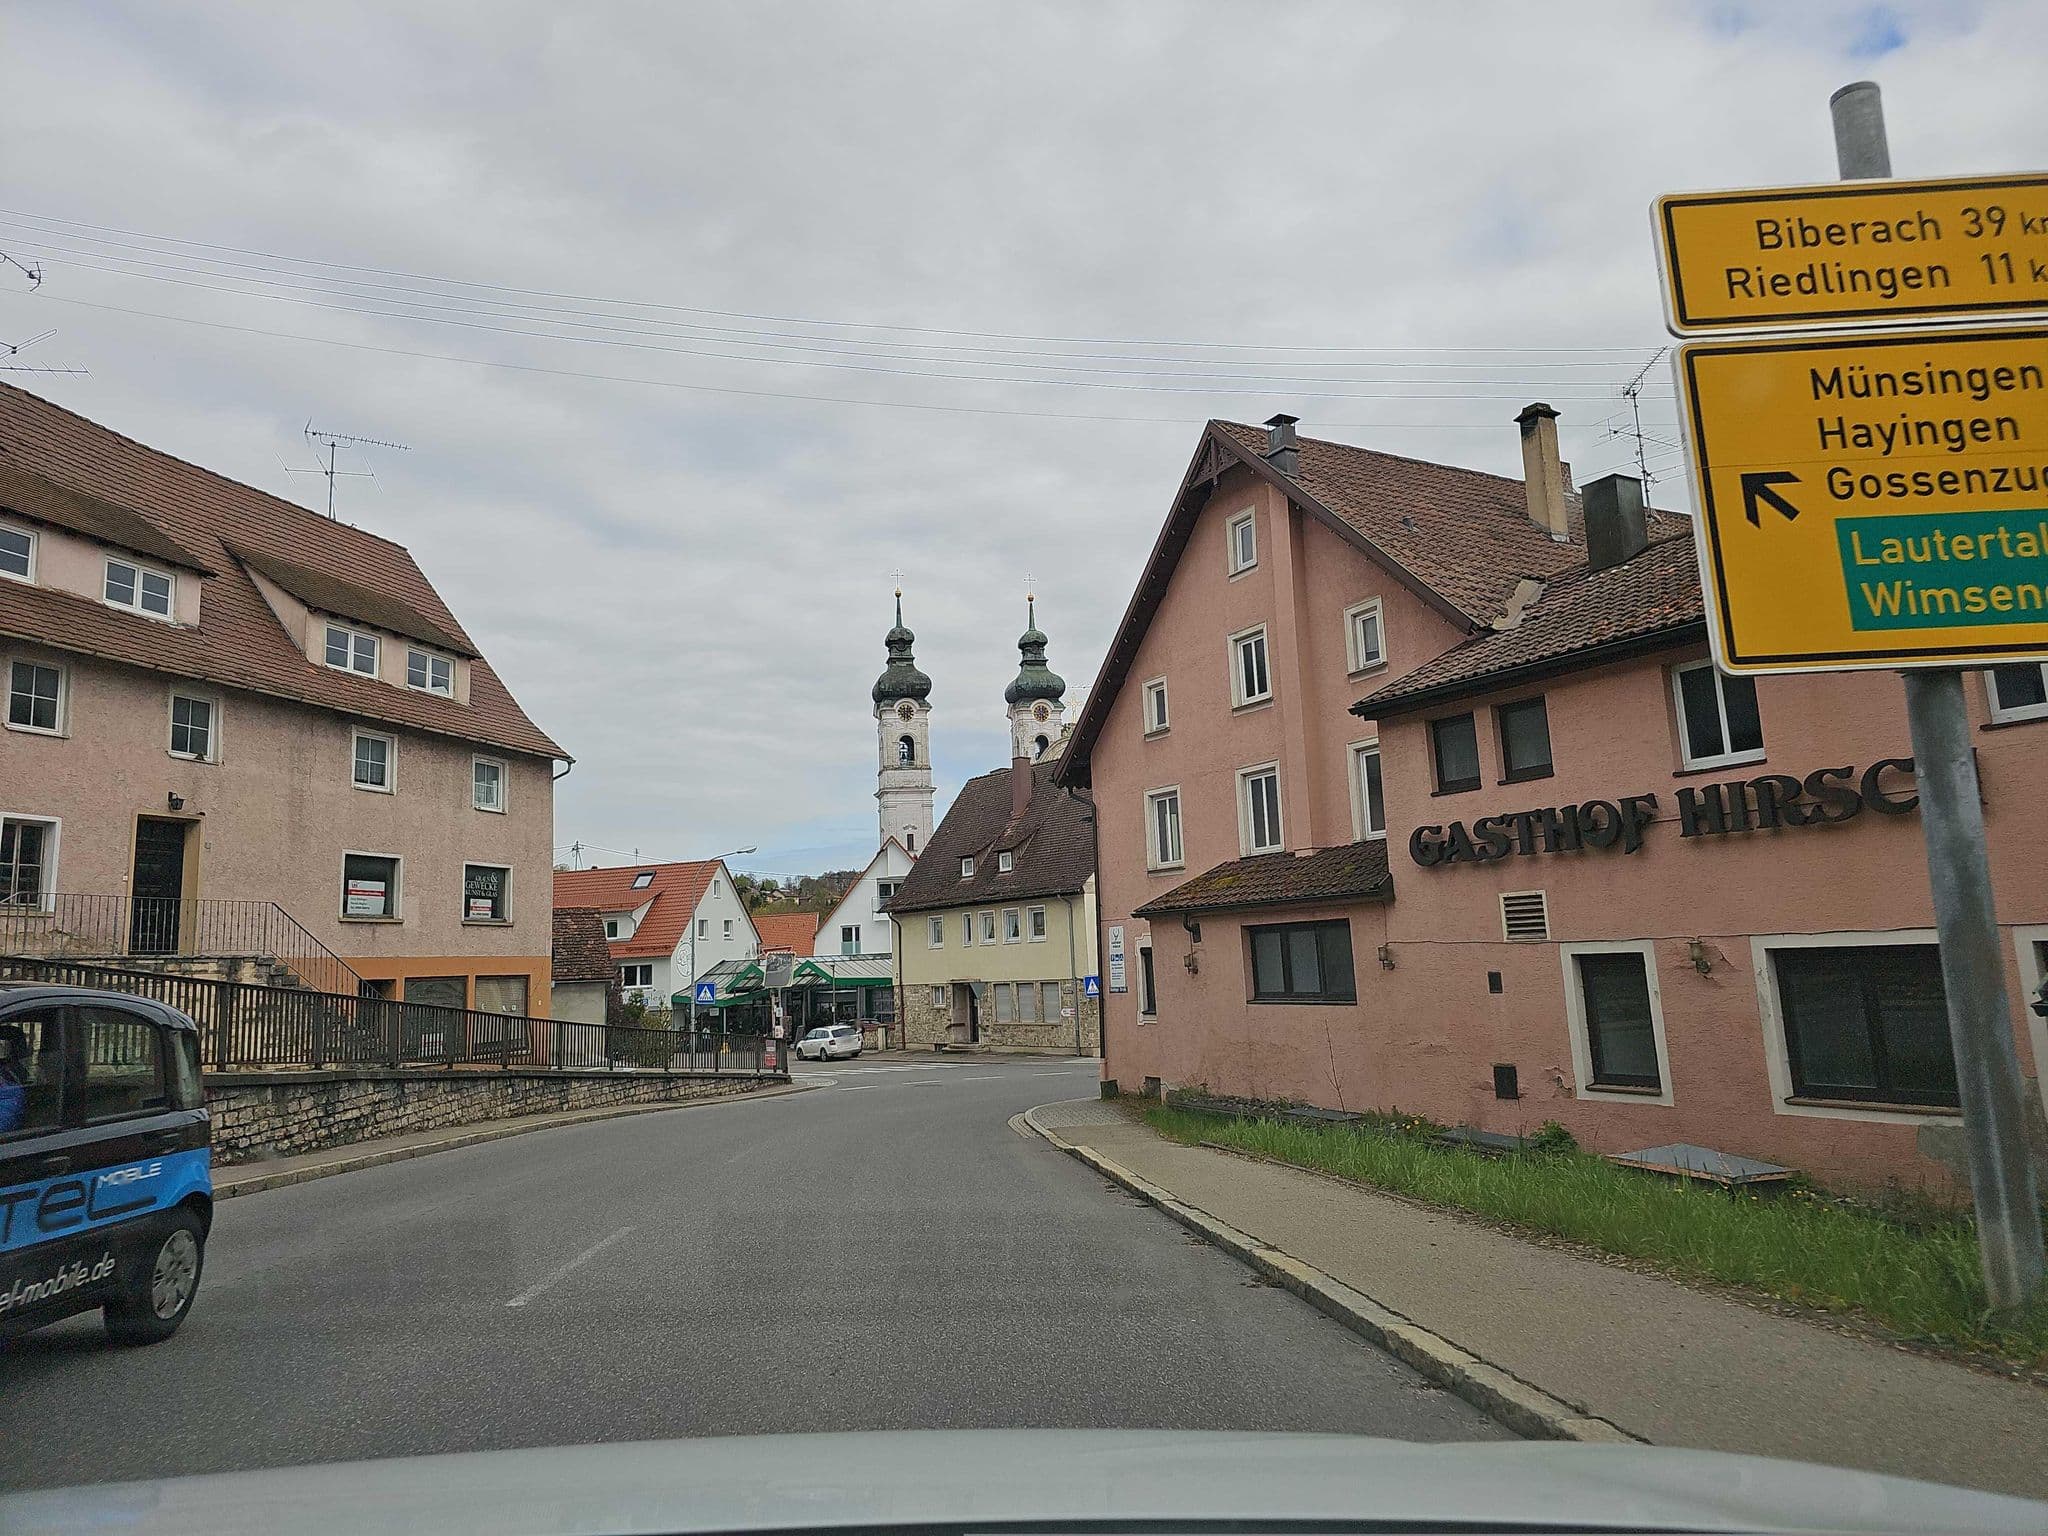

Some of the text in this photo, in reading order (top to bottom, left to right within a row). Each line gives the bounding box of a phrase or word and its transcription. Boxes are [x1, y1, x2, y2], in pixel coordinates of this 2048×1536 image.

[1757, 210, 1941, 251] Biberach
[1960, 205, 2006, 238] 39
[1726, 258, 1950, 300] Riedlingen
[1980, 252, 2015, 285] 11
[1810, 362, 2044, 402] Münsingen
[1818, 412, 2020, 456] Hayingen
[1860, 579, 2048, 618] Wimsen
[1409, 757, 1920, 869] GASTHOF HIRSC
